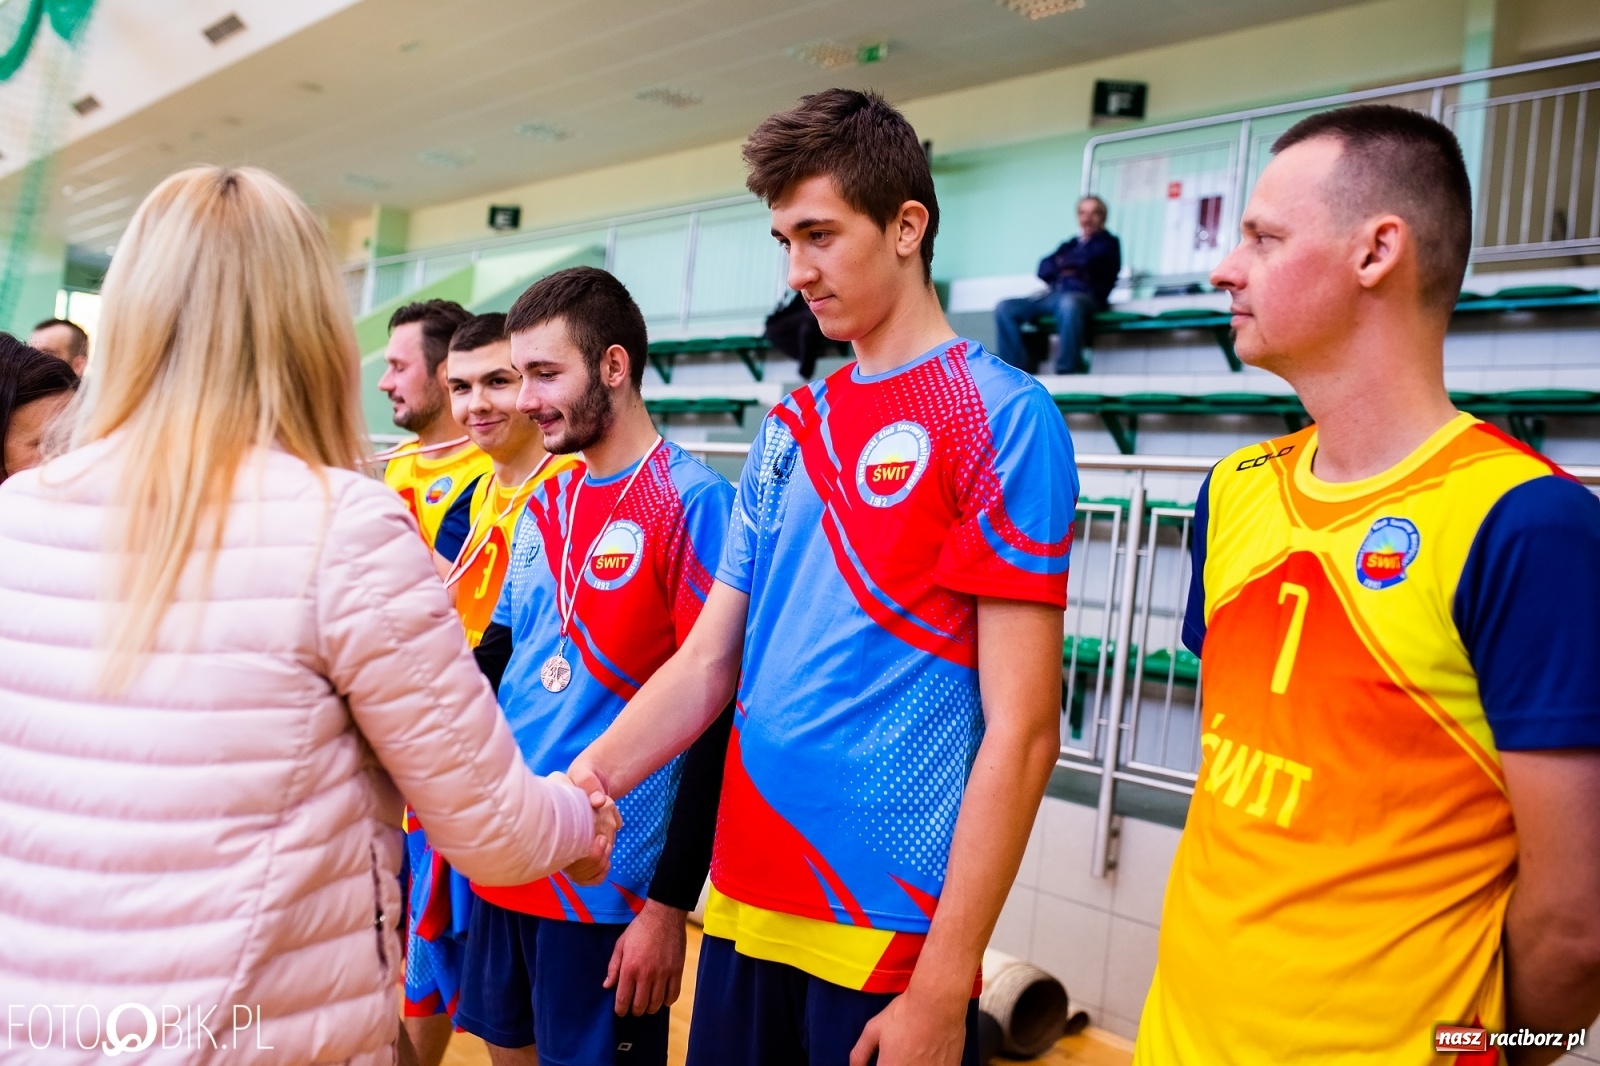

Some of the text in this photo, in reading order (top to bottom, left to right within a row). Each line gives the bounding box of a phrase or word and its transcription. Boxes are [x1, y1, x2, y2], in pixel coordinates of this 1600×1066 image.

[879, 426, 895, 438] Klub
[872, 465, 910, 482] ŚWIT
[474, 542, 497, 599] 3
[595, 555, 628, 570] ŚWIT
[593, 580, 611, 591] 1992
[1271, 582, 1309, 695] 7
[1201, 713, 1312, 829] ŚWIT
